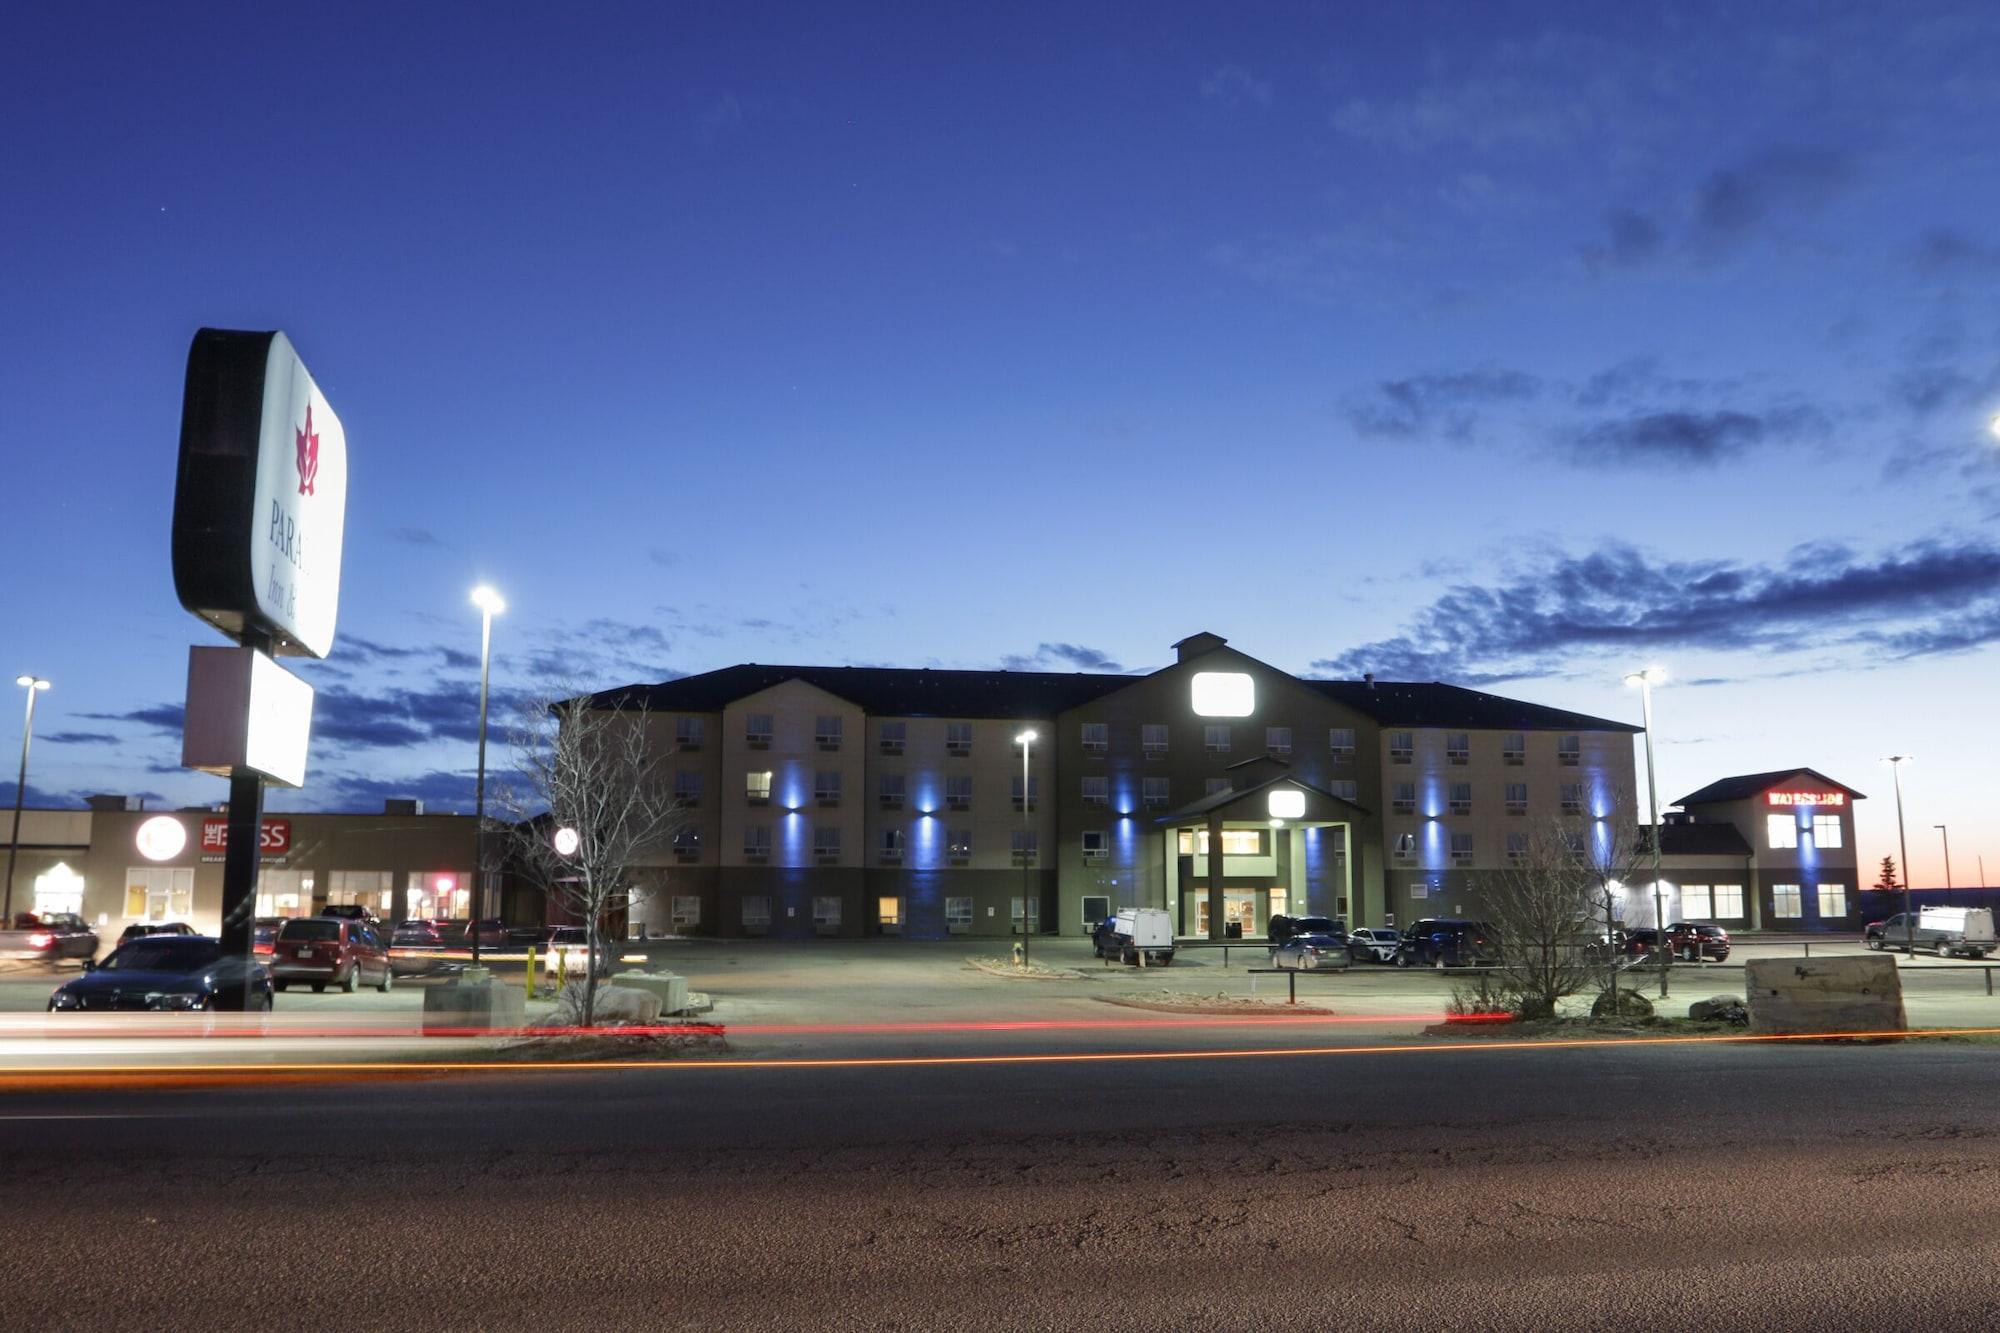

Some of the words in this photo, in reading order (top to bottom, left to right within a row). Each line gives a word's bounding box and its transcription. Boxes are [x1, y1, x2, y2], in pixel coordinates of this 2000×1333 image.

[269, 498, 304, 571] PARA
[267, 564, 285, 609] Inn
[1768, 792, 1844, 805] WATERSLIDE
[203, 824, 217, 846] THE
